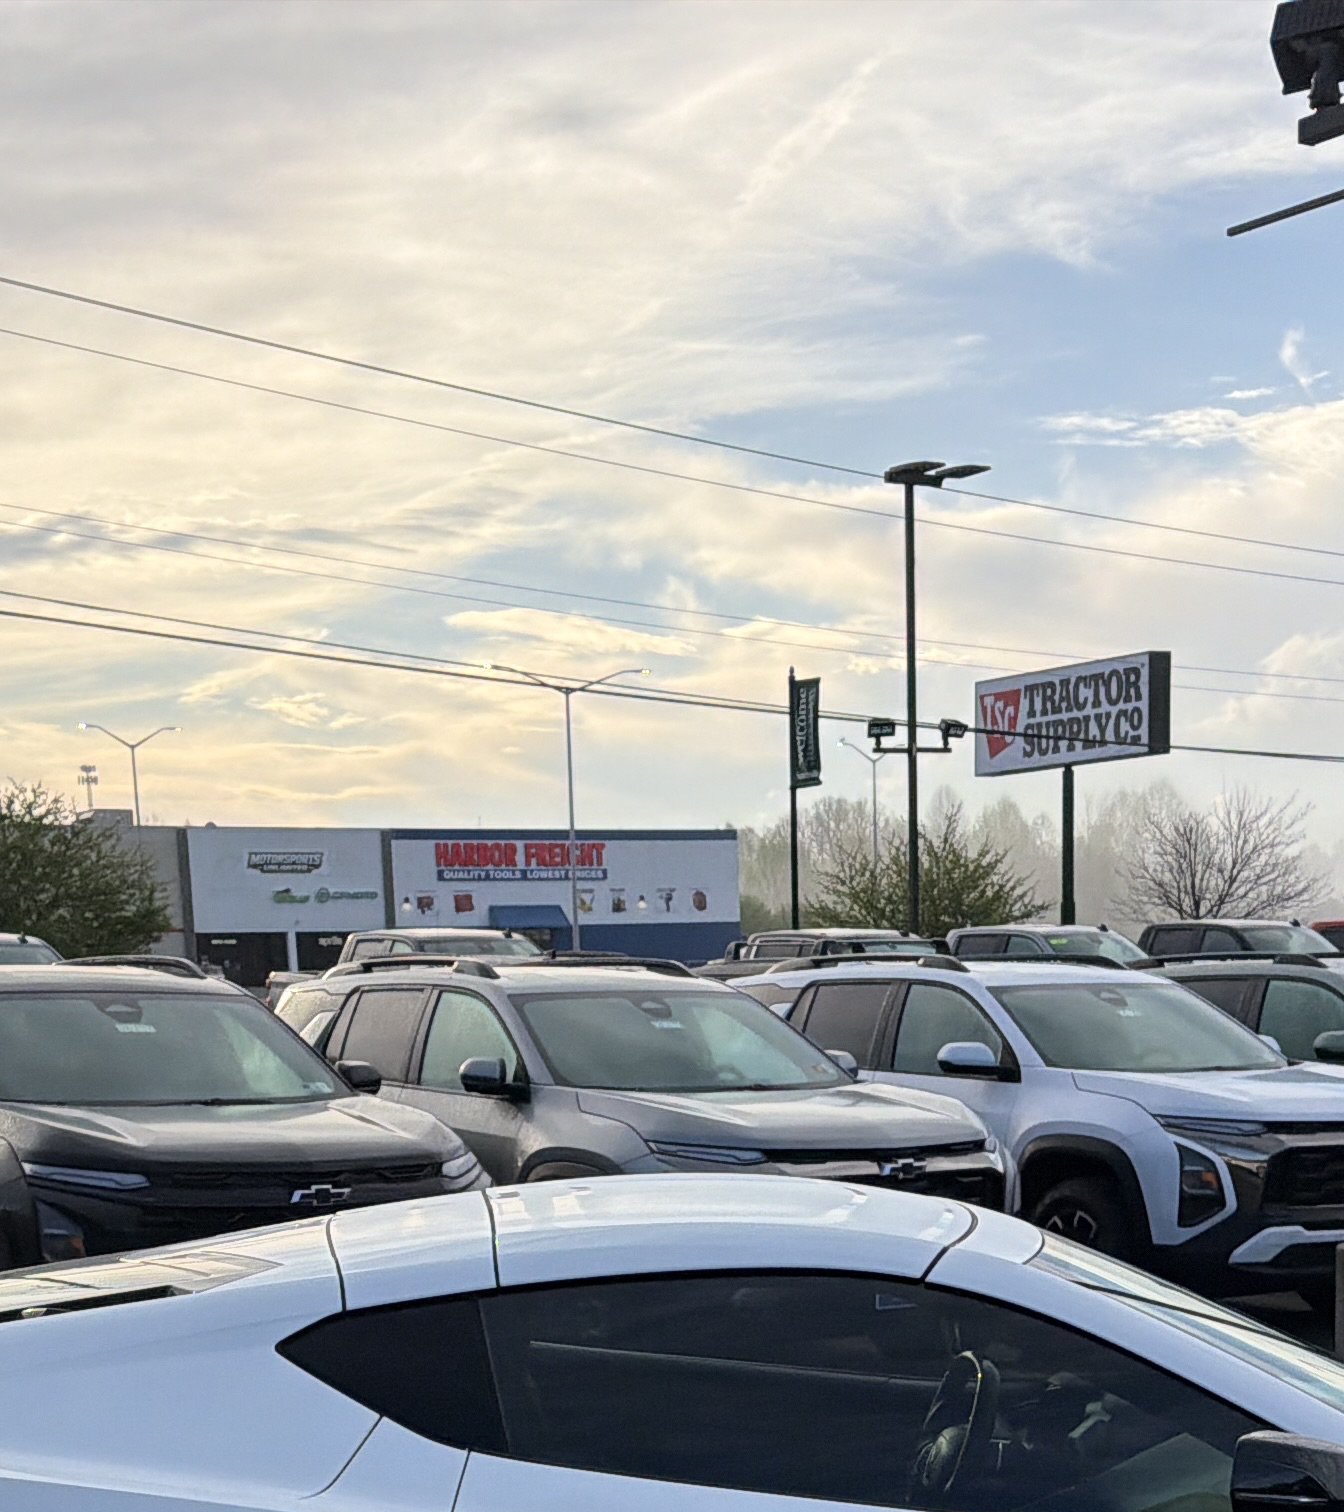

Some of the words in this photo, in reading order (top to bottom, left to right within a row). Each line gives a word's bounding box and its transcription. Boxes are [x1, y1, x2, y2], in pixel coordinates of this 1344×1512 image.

[1023, 666, 1143, 719] TRACTOR
[983, 695, 1016, 745] TSC
[1022, 711, 1113, 759] SUPPLY
[250, 854, 321, 865] MOTORSPORTS
[435, 842, 517, 867] HARBOR
[443, 870, 486, 879] QUALITY
[488, 870, 522, 879] TOOLS
[527, 870, 567, 879] LOWEST
